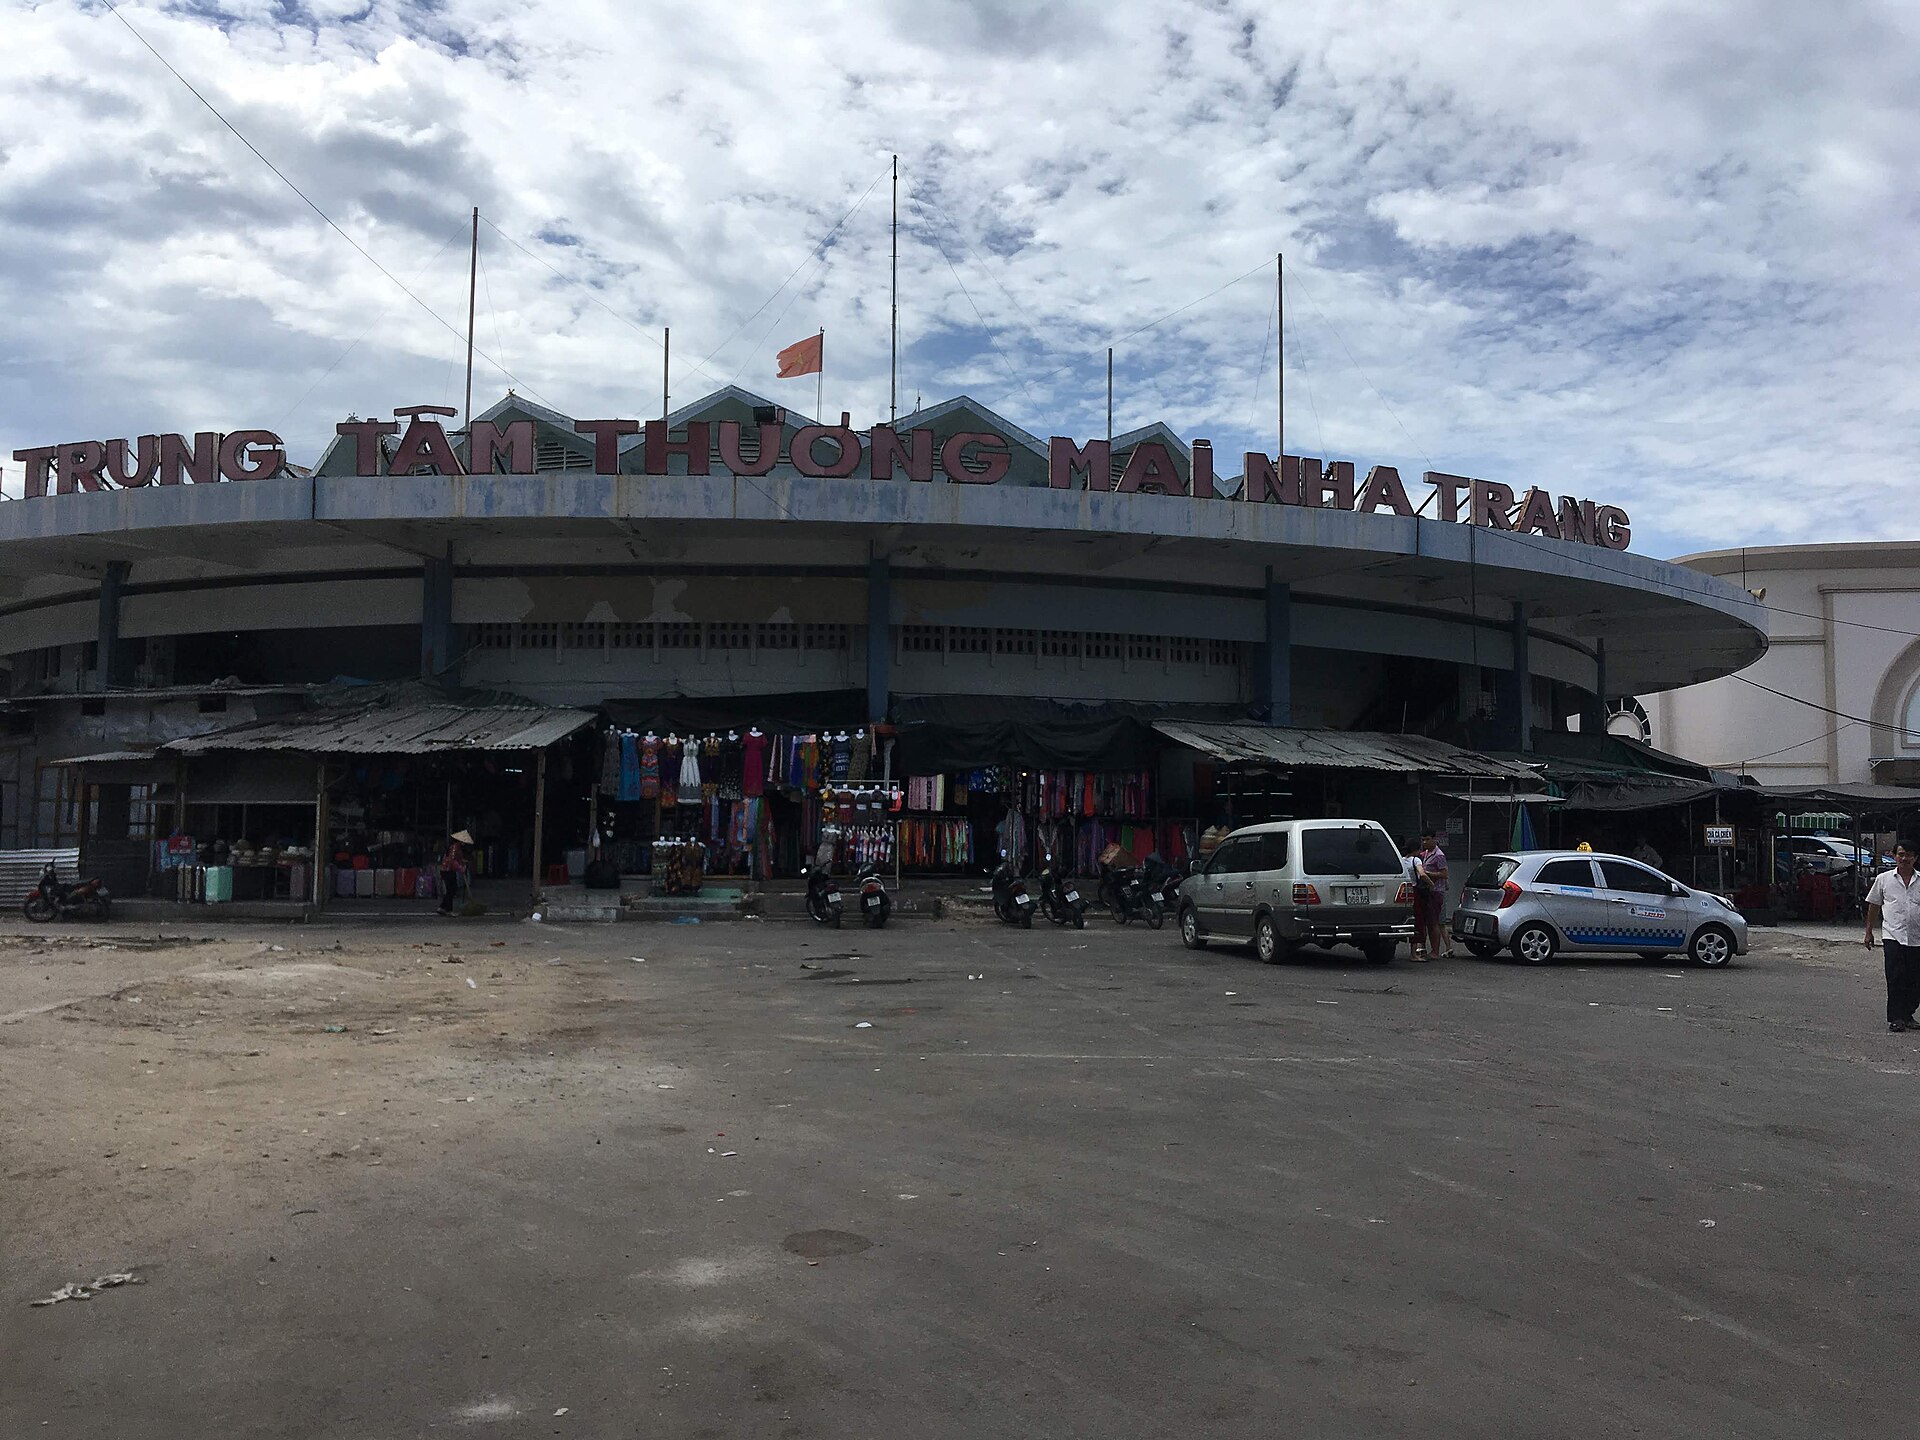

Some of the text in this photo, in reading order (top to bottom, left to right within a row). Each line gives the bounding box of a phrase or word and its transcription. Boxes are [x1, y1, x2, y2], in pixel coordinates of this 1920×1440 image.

[13, 430, 285, 497] TRUNG
[336, 405, 536, 476] TÂM
[574, 408, 1012, 485] THƯƠNG
[1243, 451, 1415, 517] NHA
[1422, 471, 1631, 551] TRANG
